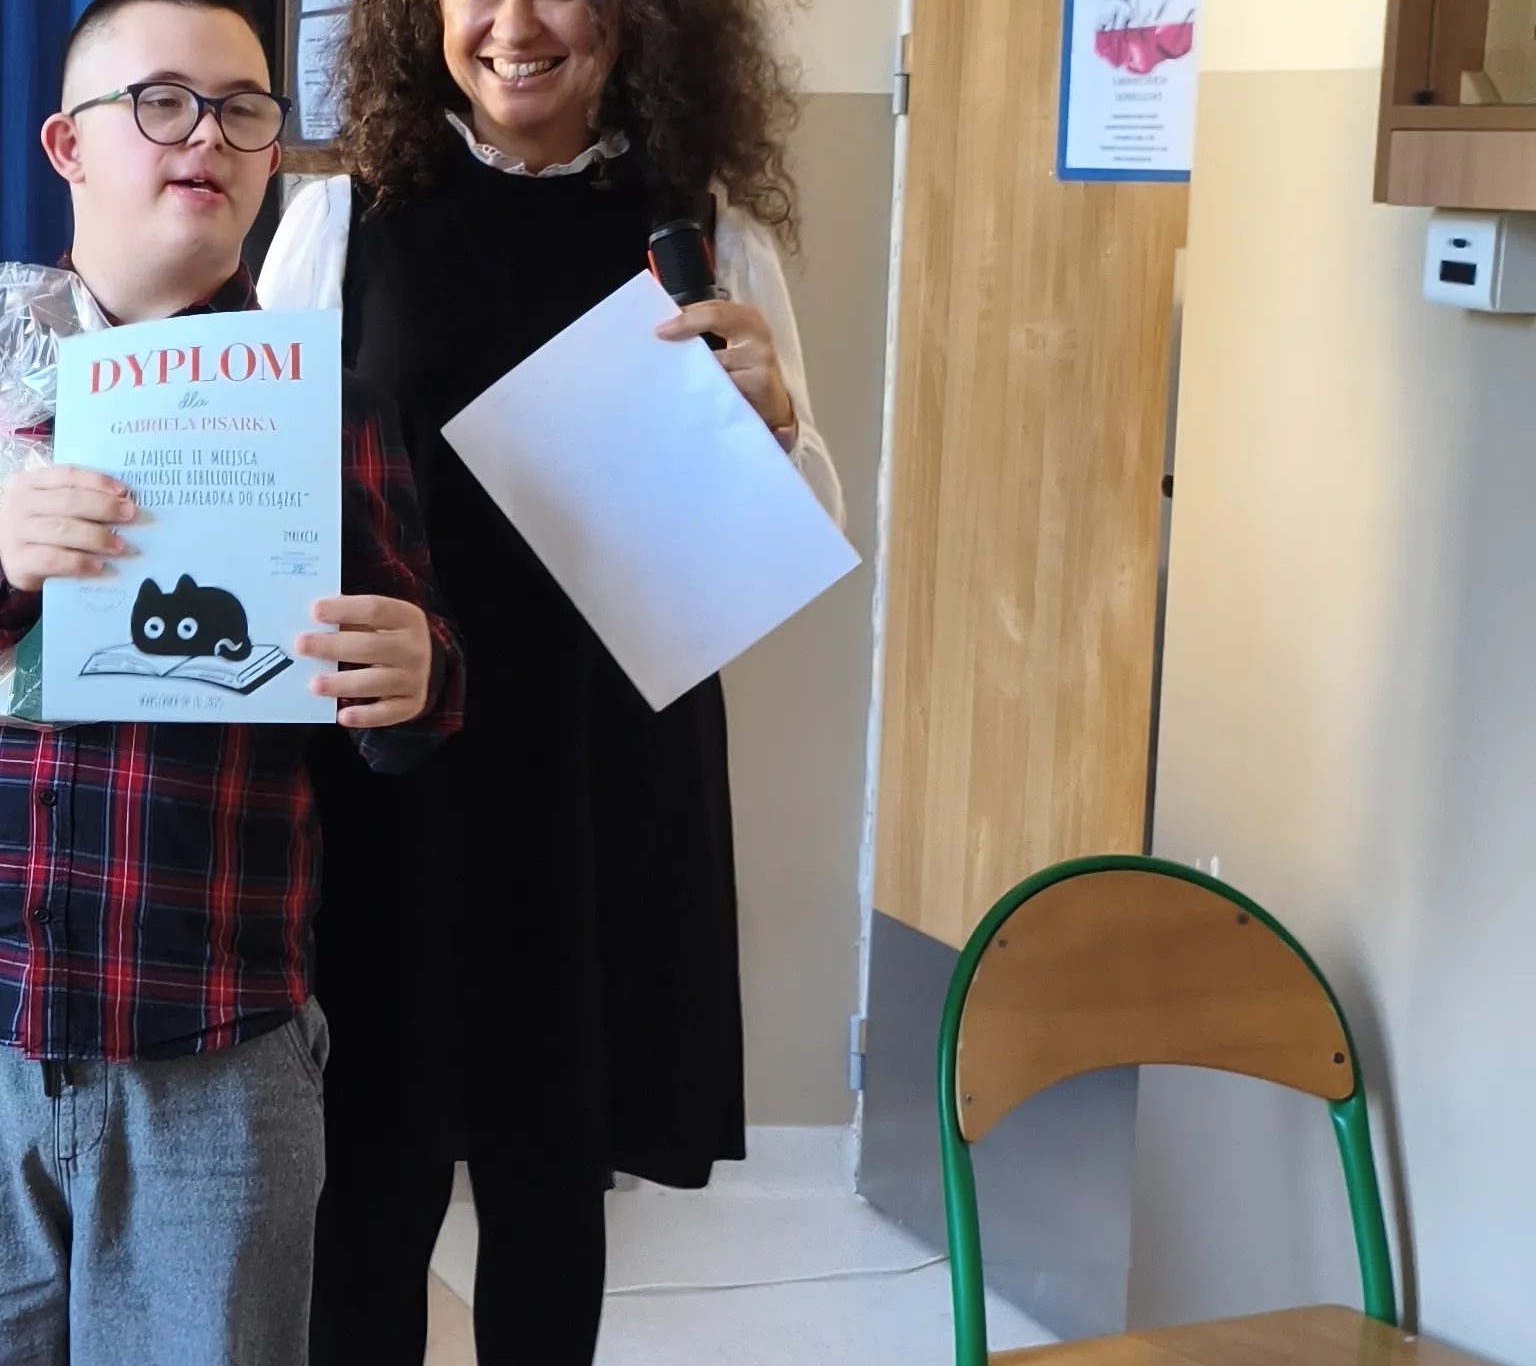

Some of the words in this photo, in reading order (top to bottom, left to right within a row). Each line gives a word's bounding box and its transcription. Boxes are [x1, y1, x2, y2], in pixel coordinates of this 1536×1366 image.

[89, 342, 304, 395] DYPLOM
[178, 391, 209, 410] dla
[111, 418, 196, 434] GABRIELA
[124, 450, 136, 466] ZA
[141, 449, 183, 467] ZAJĘCIE
[212, 449, 257, 466] MIEJSCA
[239, 490, 252, 506] DO
